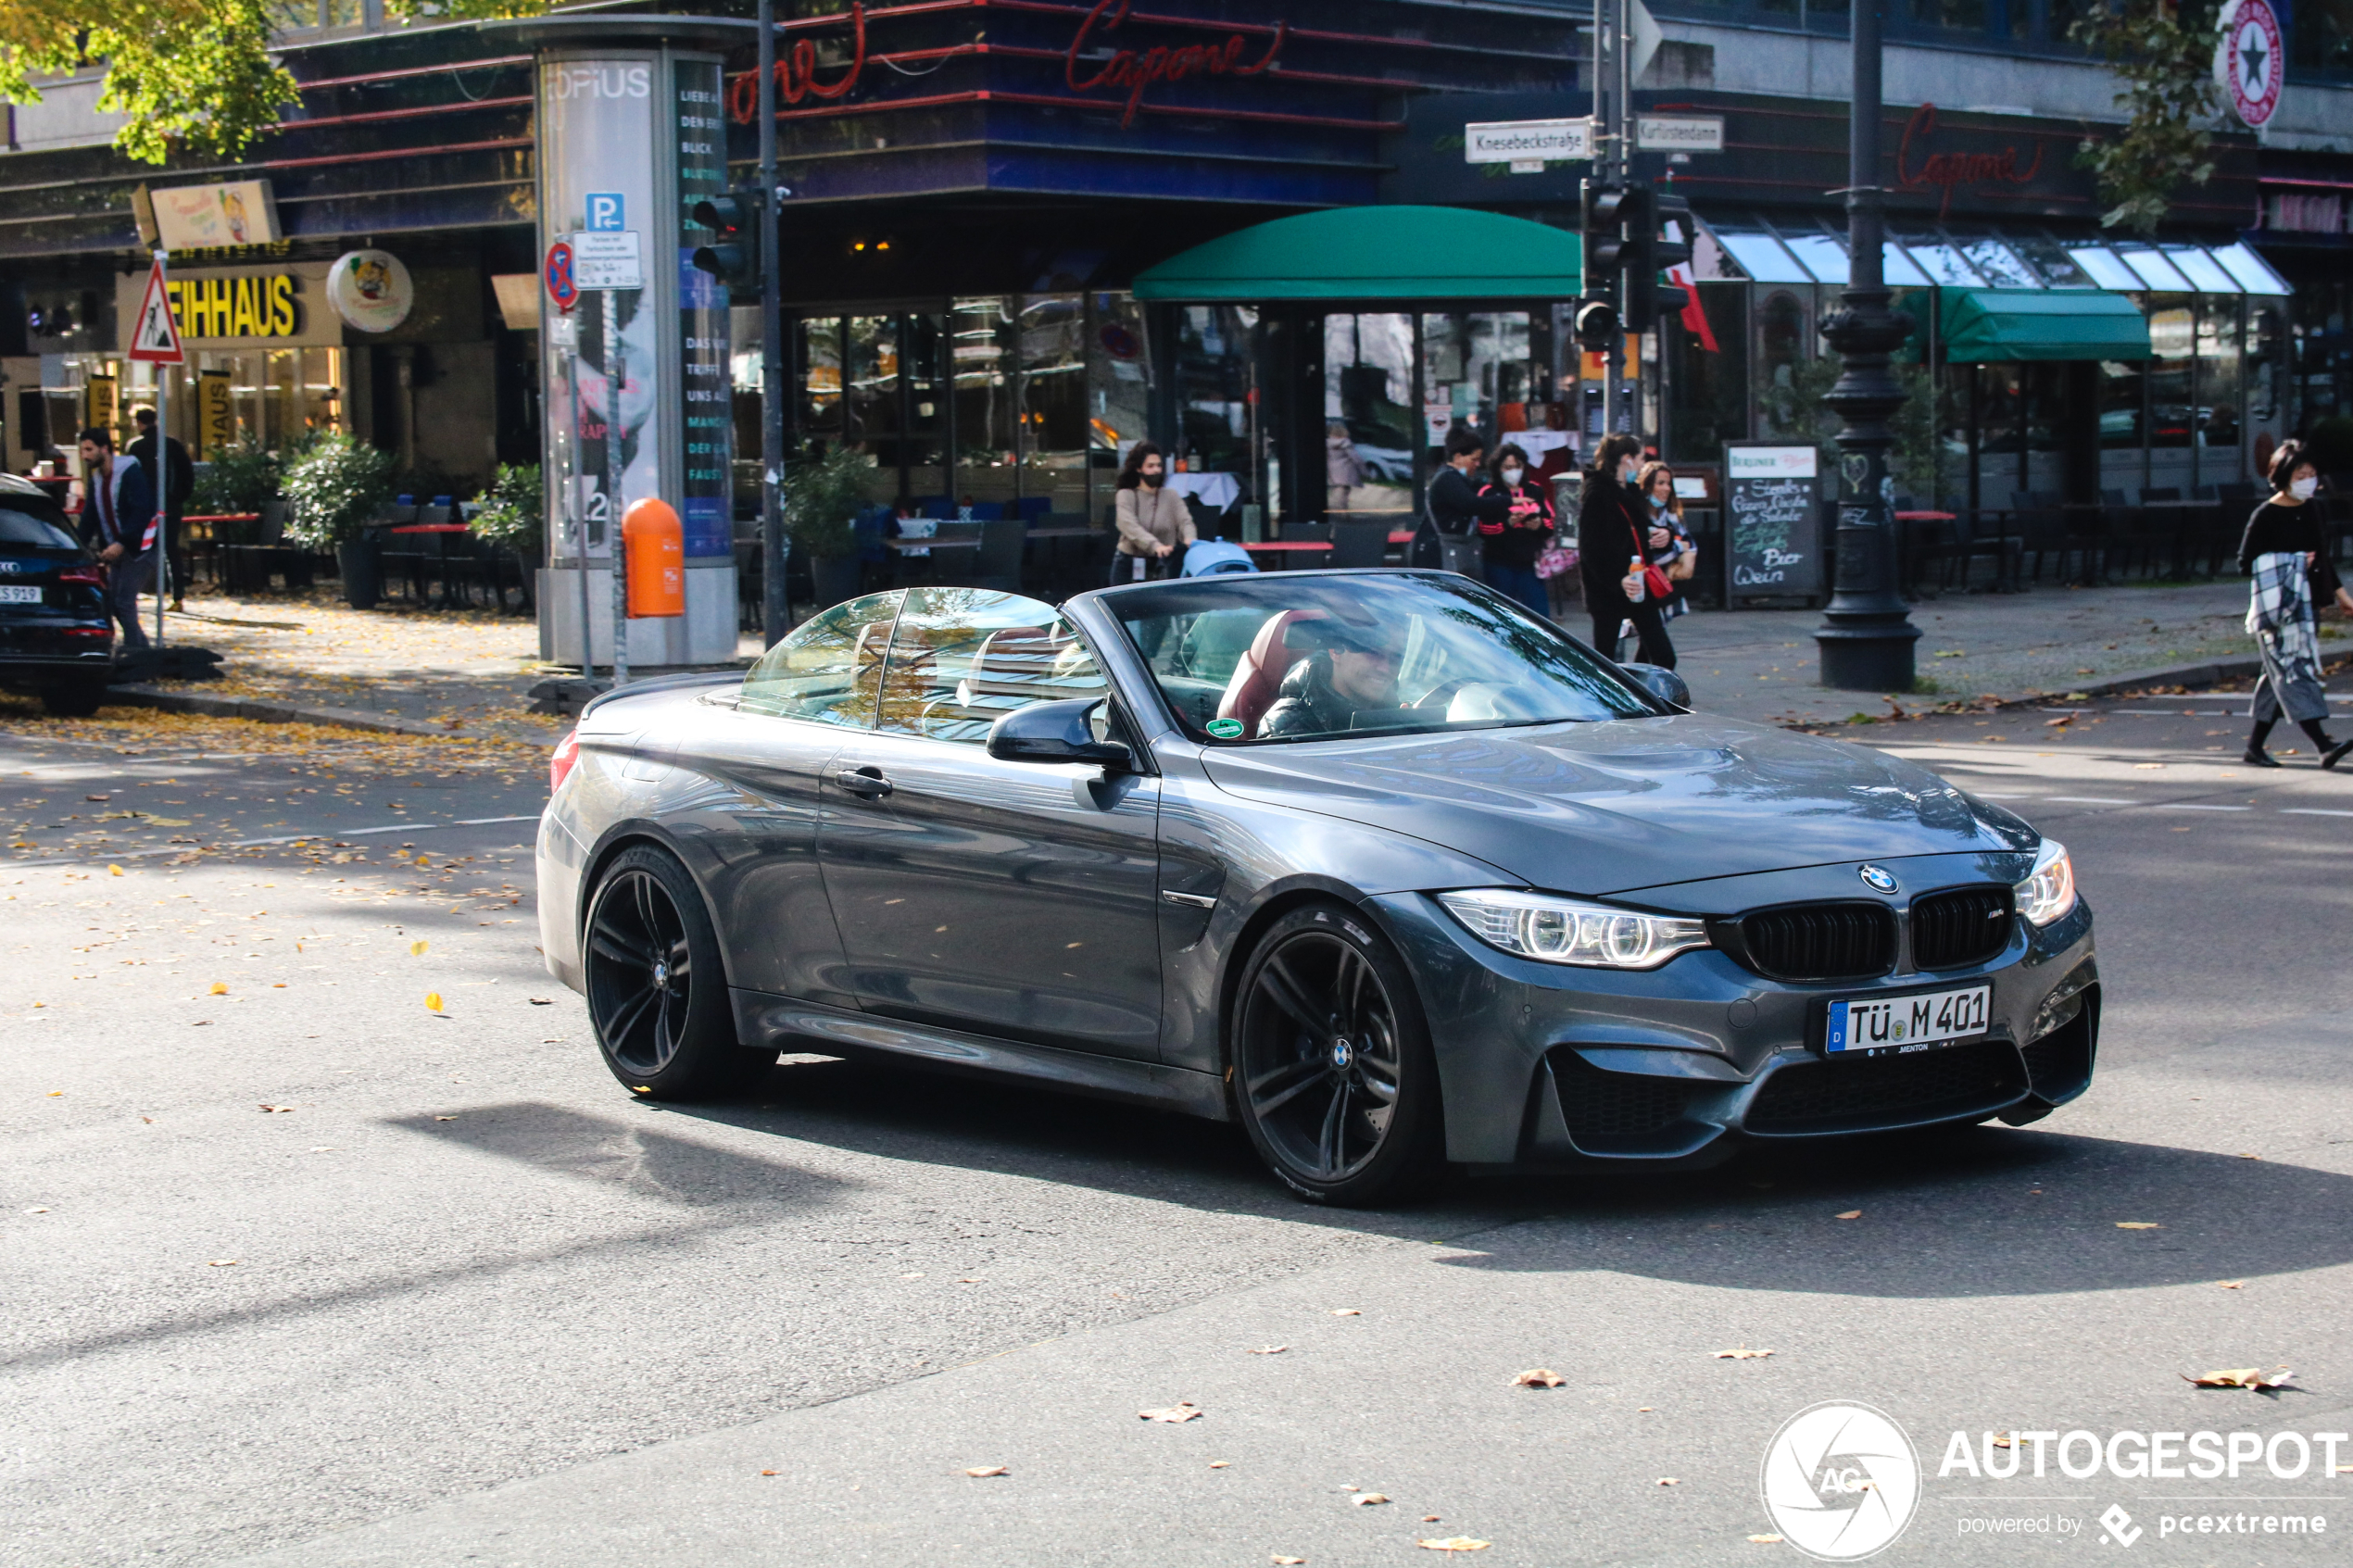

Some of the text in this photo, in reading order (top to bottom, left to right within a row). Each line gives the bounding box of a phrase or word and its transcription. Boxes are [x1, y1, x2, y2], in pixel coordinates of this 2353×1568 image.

[724, 1, 865, 125] one
[1066, 0, 1285, 130] Capone
[680, 90, 710, 102] LIEBE
[680, 115, 705, 128] DEN
[1640, 121, 1718, 140] Kurfürstendamm
[1476, 132, 1581, 152] Knesebeckstraße
[1899, 102, 2044, 221] Capone
[594, 197, 616, 229] P
[167, 274, 295, 337] EIHHAUS
[686, 337, 710, 349] DAS
[686, 390, 711, 402] UNS
[211, 383, 229, 448] HAUS
[688, 443, 711, 454] DER
[1761, 547, 1804, 568] Bier
[1733, 564, 1784, 585] Wein
[12, 588, 36, 600] 919
[1850, 991, 1985, 1044] TÜ M 401
[1833, 1032, 1842, 1043] D
